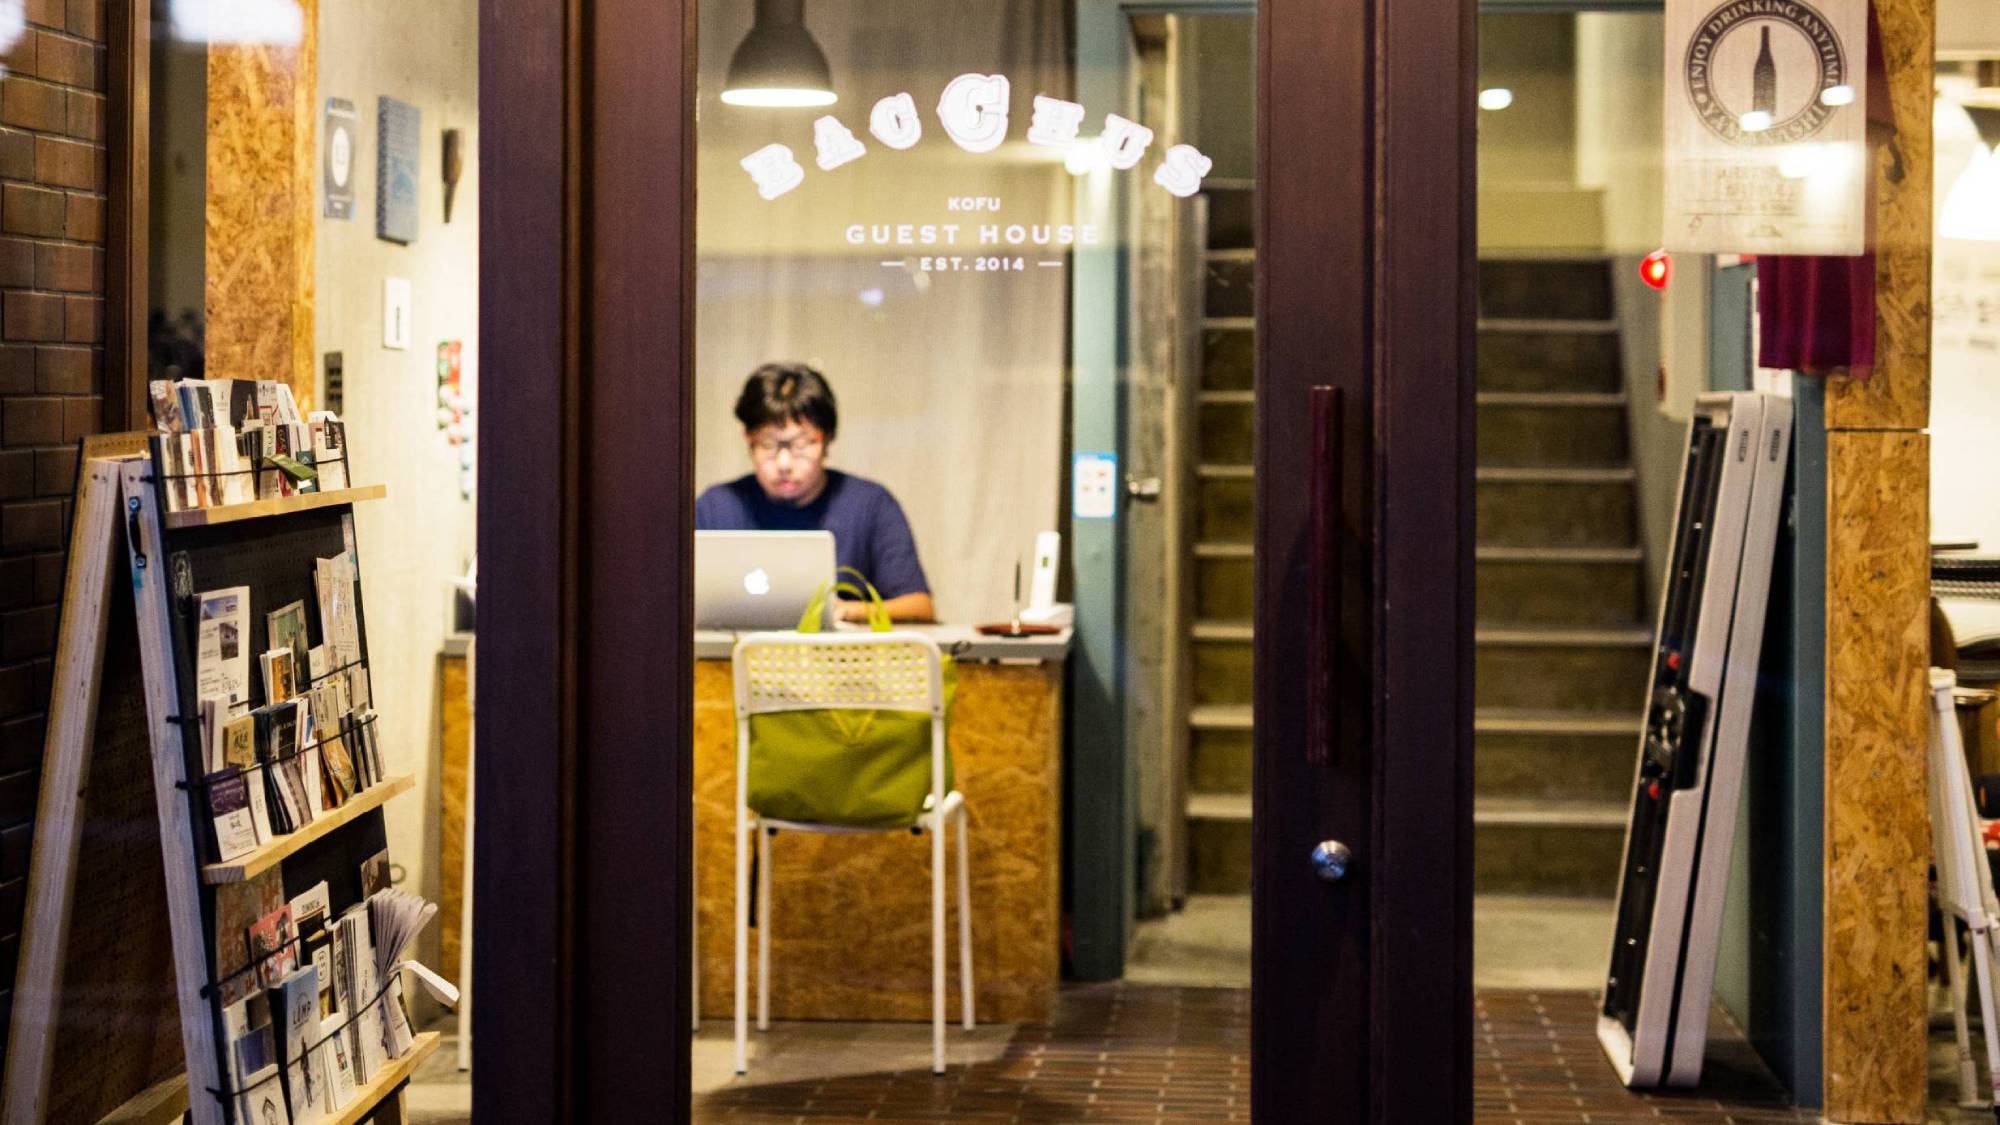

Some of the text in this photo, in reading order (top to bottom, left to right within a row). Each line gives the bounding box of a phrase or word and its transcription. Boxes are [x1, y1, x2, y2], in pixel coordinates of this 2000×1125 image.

[1691, 37, 1713, 90] ENJOY
[1708, 0, 1799, 33] DRINKING
[740, 73, 1213, 201] BACCHUS
[948, 197, 1001, 212] KOFU
[845, 224, 1100, 246] GUEST HOUSE
[920, 256, 1025, 272] EST. 2014
